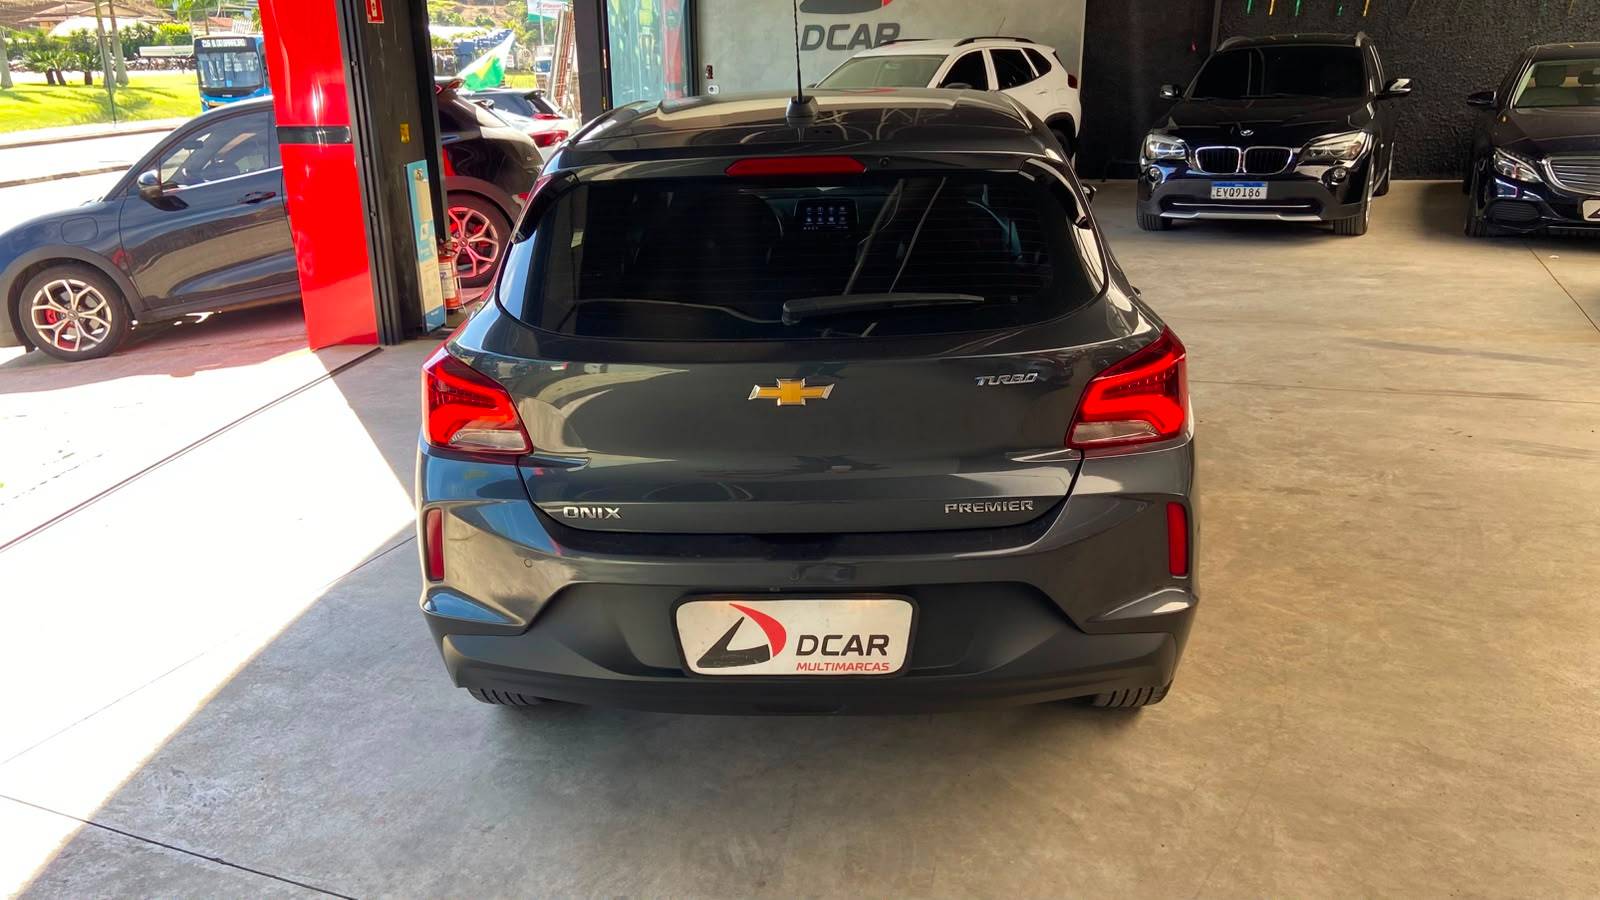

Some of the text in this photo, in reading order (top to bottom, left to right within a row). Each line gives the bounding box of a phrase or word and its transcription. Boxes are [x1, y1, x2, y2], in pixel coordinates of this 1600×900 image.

[975, 372, 1038, 386] TURBO
[563, 506, 622, 520] ONIX
[944, 500, 1034, 514] PREMIER
[796, 634, 889, 656] DCAR
[796, 662, 890, 672] MULTIMARCAS
